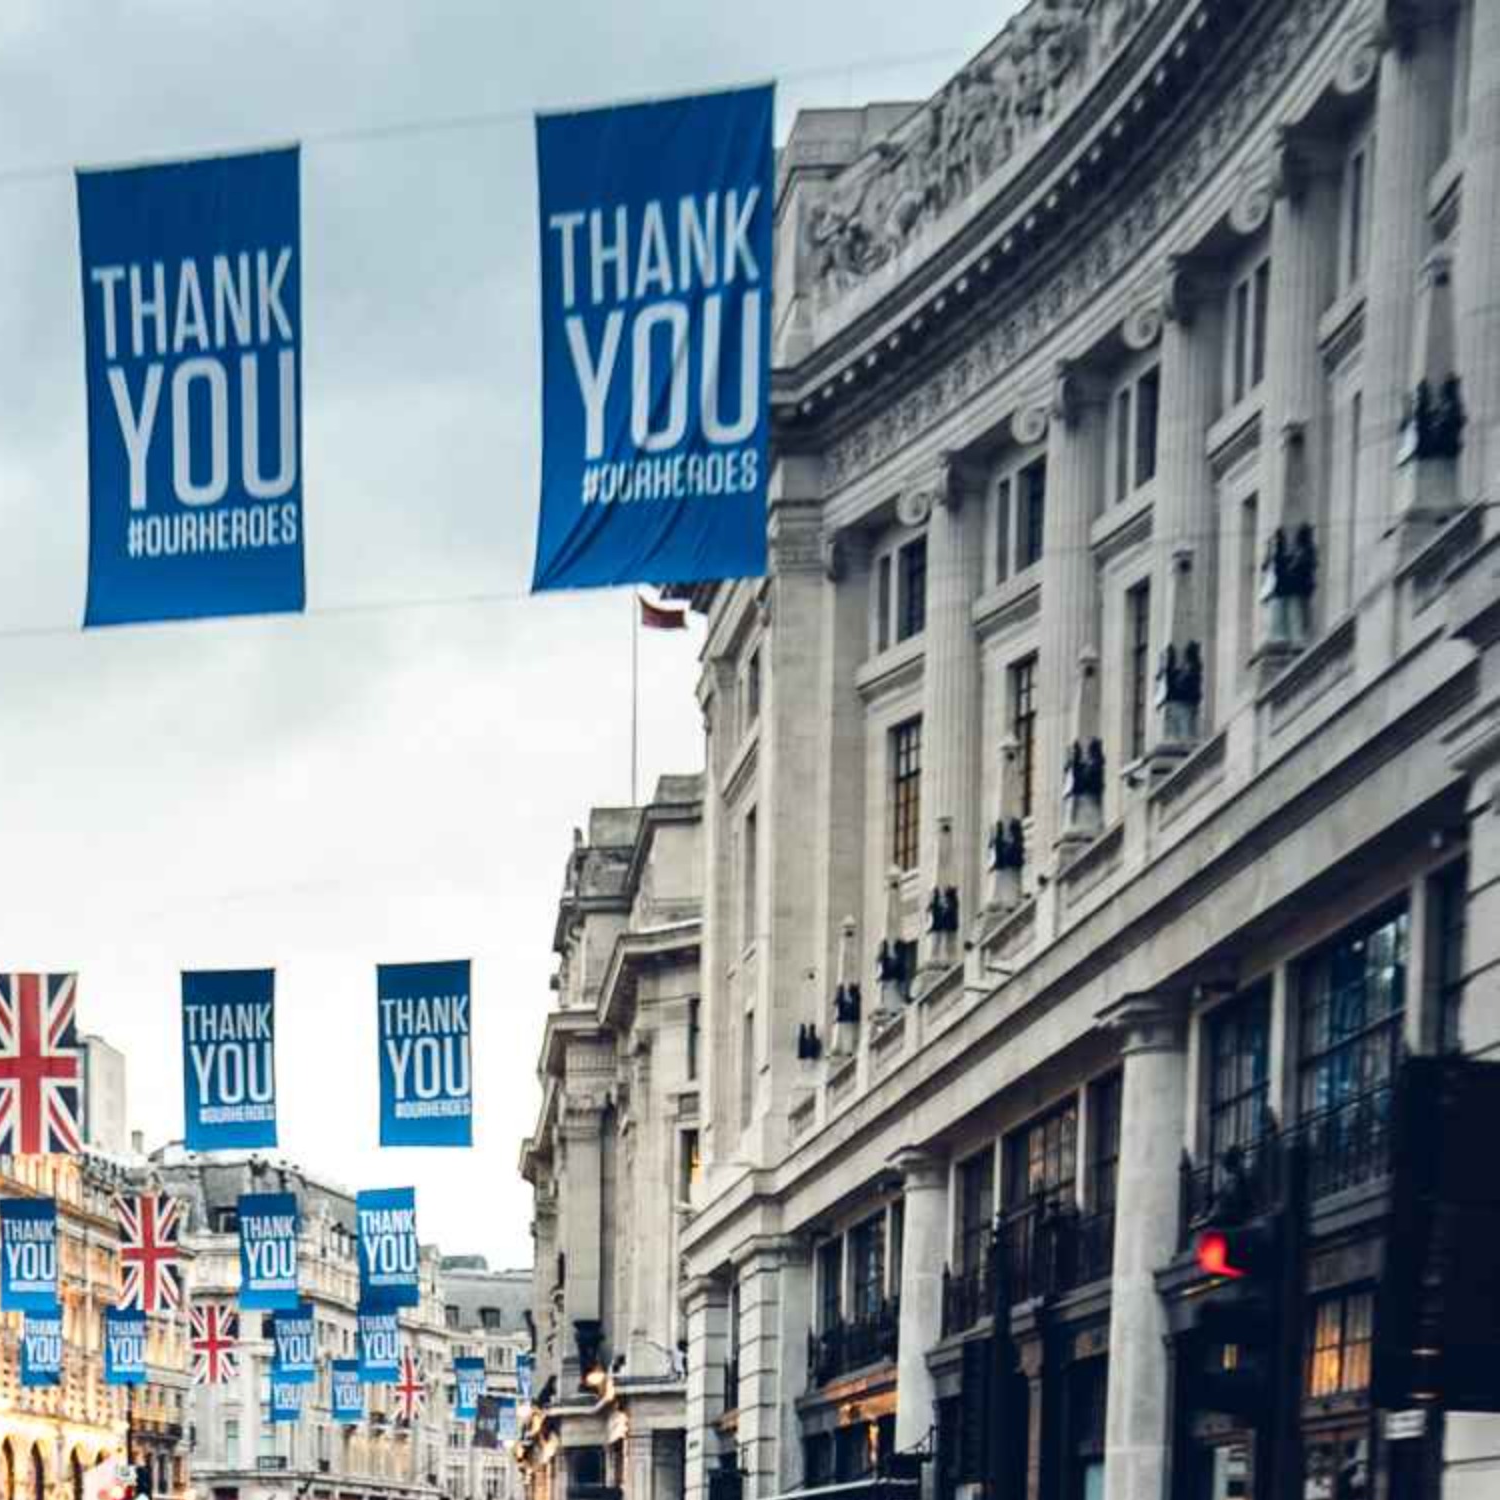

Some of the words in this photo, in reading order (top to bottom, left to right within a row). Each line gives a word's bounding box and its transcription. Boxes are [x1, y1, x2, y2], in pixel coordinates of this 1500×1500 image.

[549, 186, 760, 308] THANK
[92, 247, 293, 360] THANK
[564, 290, 761, 460] YOU
[107, 349, 295, 510] YOU
[582, 450, 757, 504] #OURHEROES
[128, 503, 296, 558] #OURHEROES
[185, 1002, 271, 1041] THANK
[380, 995, 468, 1035] THANK
[190, 1042, 273, 1104] YOU
[386, 1036, 469, 1100] YOU
[4, 1219, 54, 1241] THANK
[240, 1216, 295, 1238] THANK
[359, 1209, 413, 1233] THANK
[6, 1243, 55, 1280] YOU
[244, 1239, 295, 1279] YOU
[363, 1233, 416, 1272] YOU
[26, 1336, 61, 1363] YOU
[109, 1337, 146, 1363] YOU
[278, 1335, 314, 1363] YOU
[363, 1331, 398, 1360] YOU
